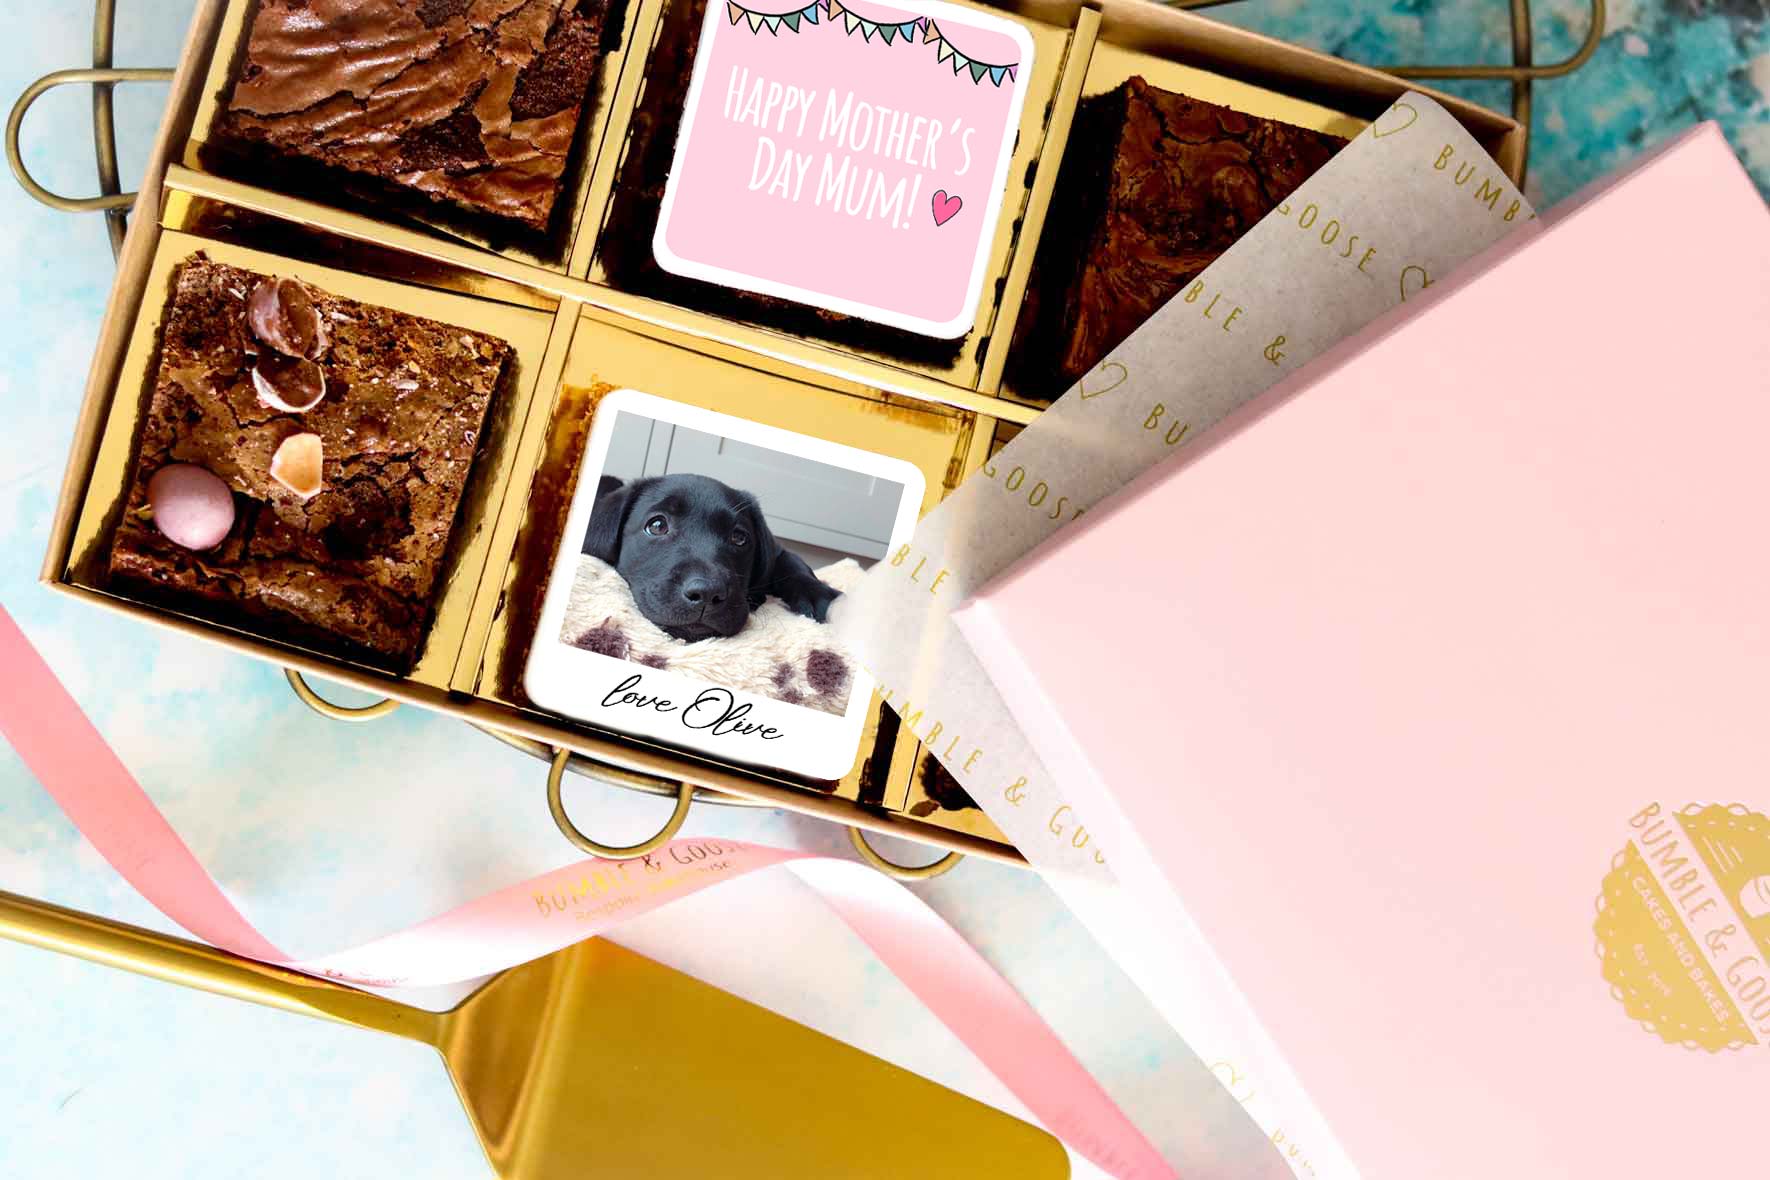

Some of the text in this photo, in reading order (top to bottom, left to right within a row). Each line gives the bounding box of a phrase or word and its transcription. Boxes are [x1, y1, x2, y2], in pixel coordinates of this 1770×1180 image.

[724, 65, 816, 138] HAPPY
[748, 137, 922, 231] DAY MUM!
[1433, 143, 1537, 222] BUMB
[1263, 335, 1287, 367] &
[601, 674, 784, 740] love Olive
[1003, 776, 1029, 807] &
[1629, 801, 1718, 923] BUMBLE
[1704, 923, 1737, 959] &
[1632, 874, 1674, 932] CAKES
